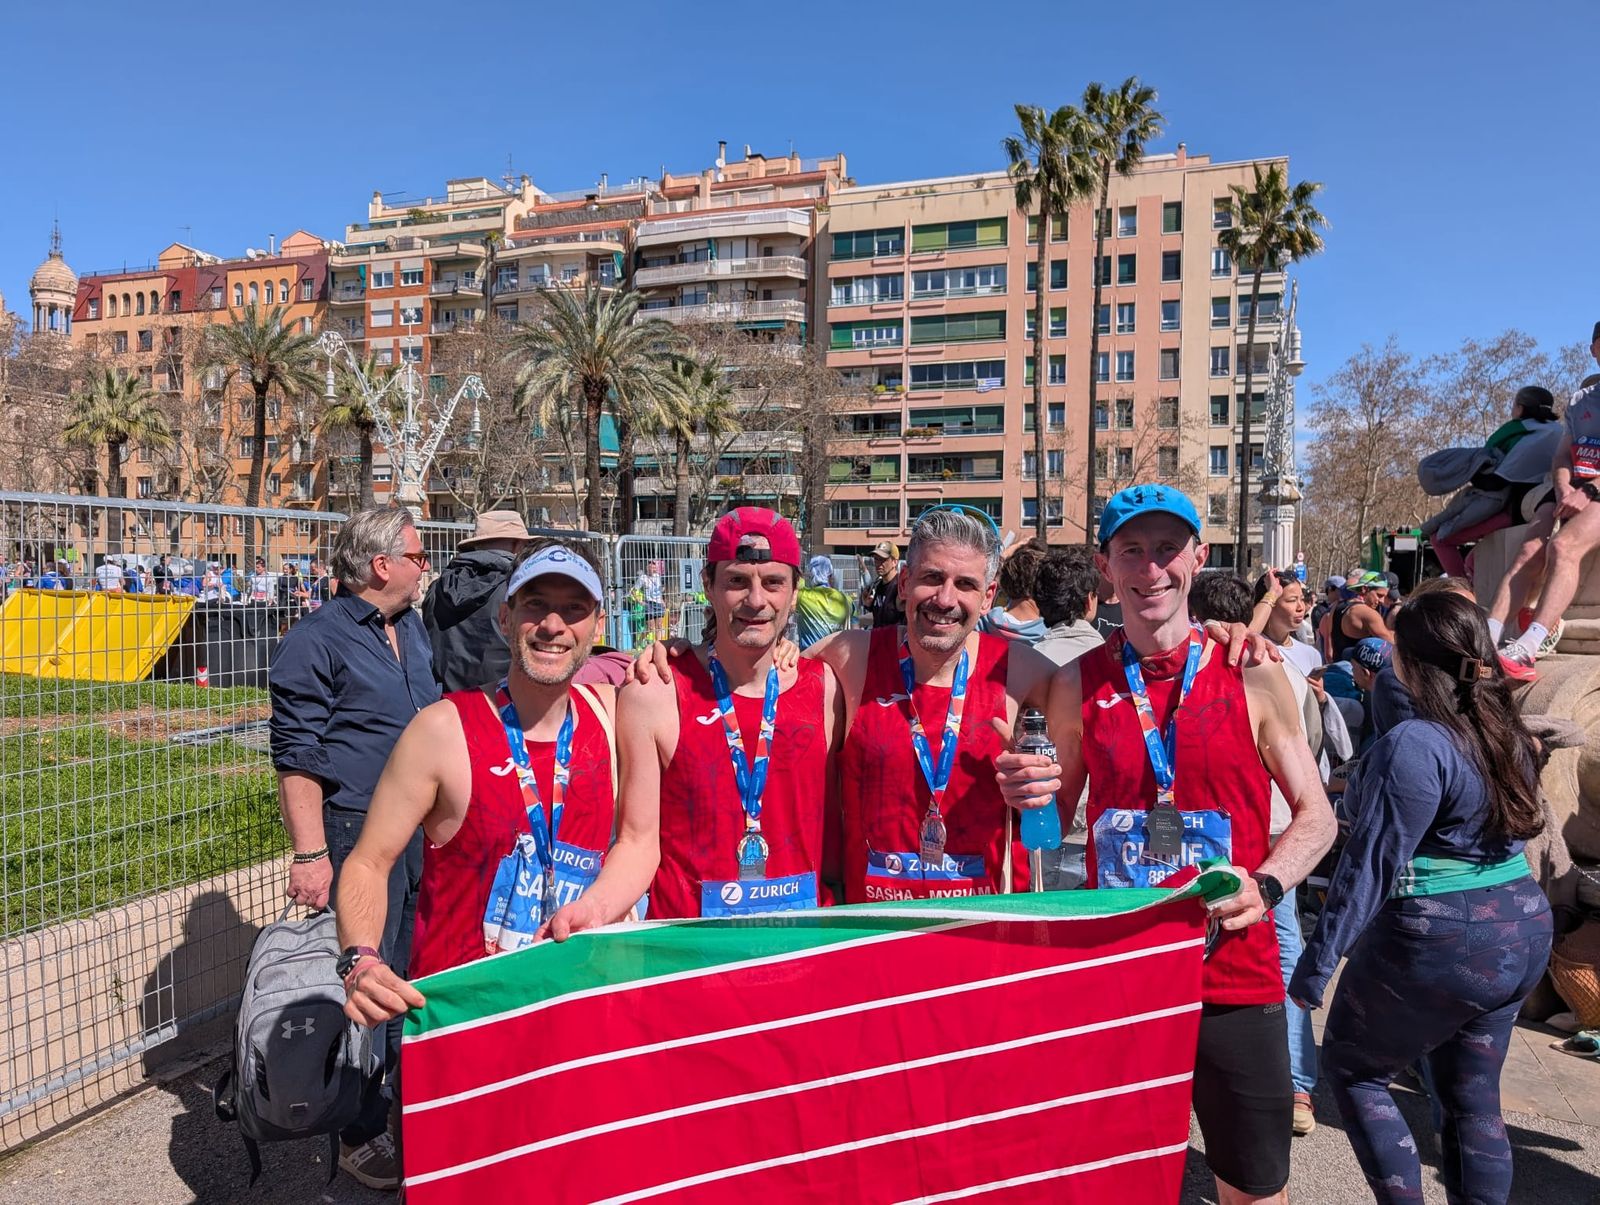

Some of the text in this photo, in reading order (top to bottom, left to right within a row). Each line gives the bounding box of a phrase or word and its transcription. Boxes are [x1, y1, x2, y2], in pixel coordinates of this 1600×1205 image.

[553, 848, 595, 870] URICH
[749, 882, 799, 899] ZURICH
[866, 885, 913, 901] SASHA
